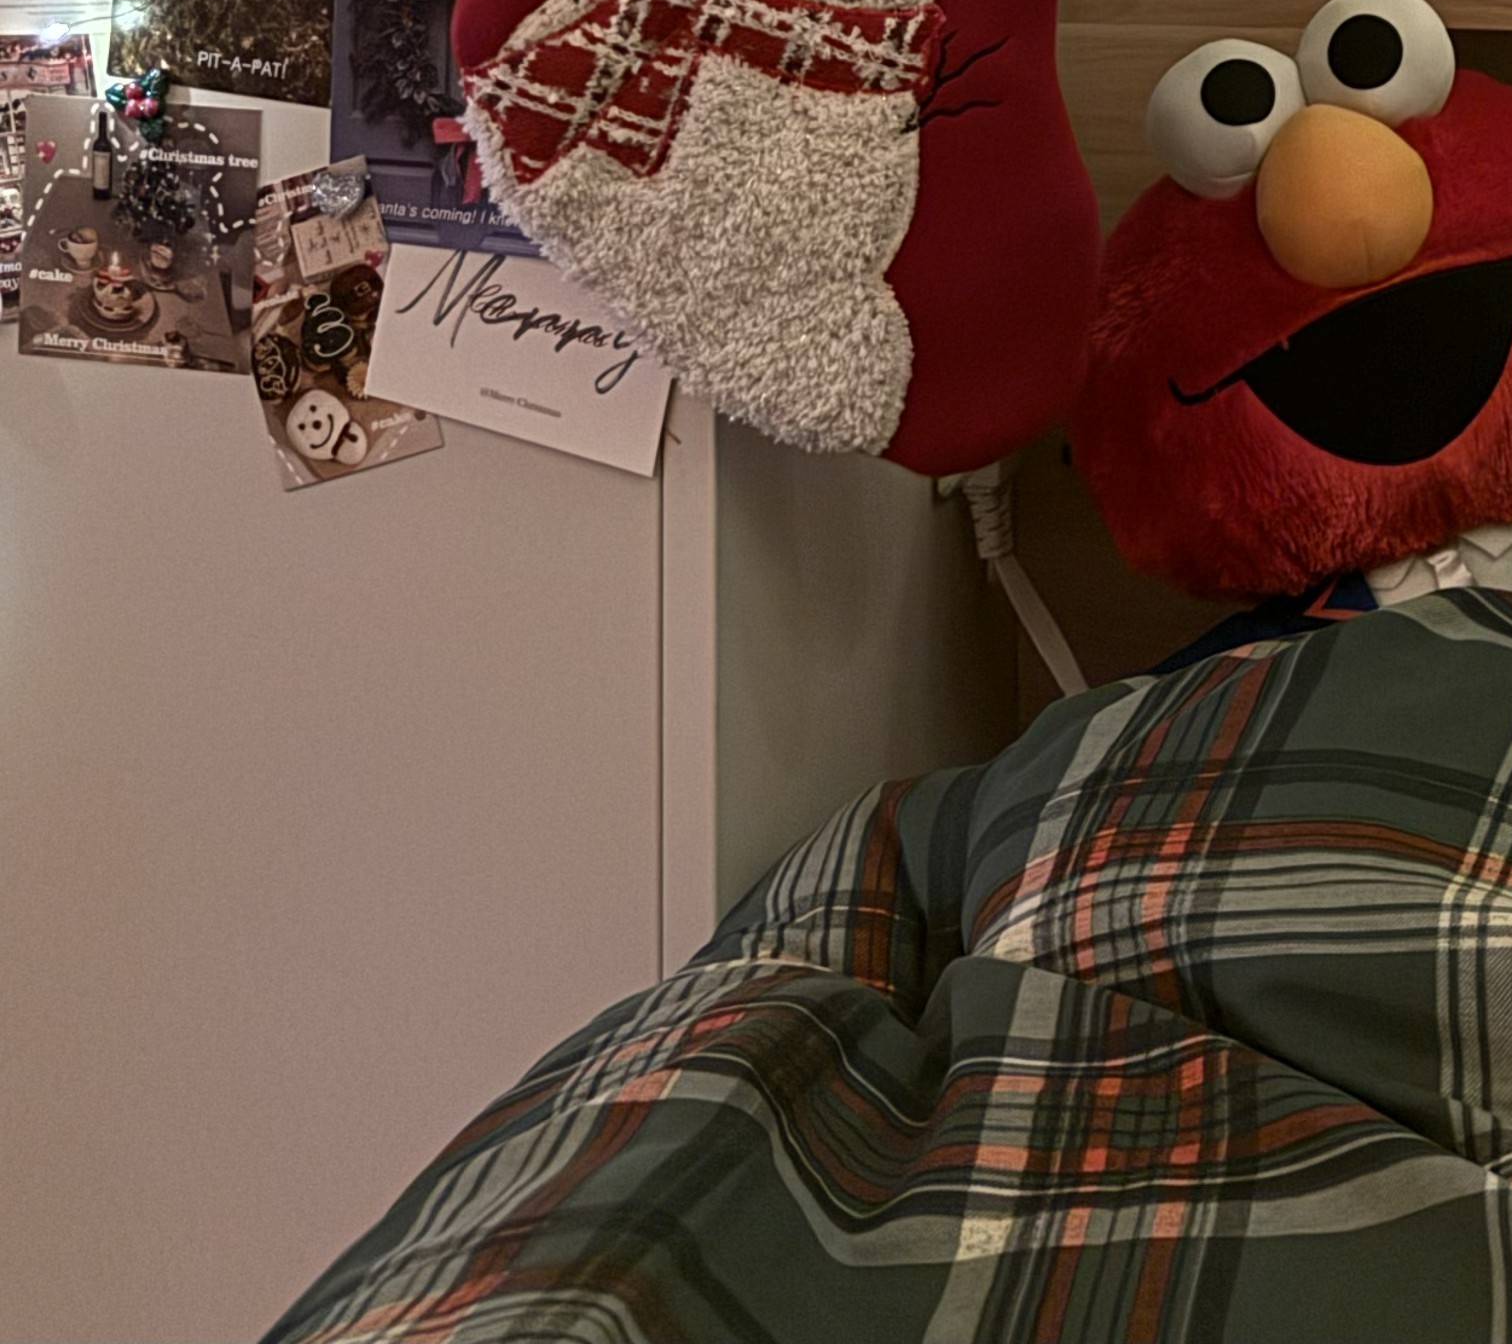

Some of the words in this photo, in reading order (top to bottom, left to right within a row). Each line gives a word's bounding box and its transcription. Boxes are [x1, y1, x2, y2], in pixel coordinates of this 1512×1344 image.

[197, 50, 289, 79] PIT-A-PAT!
[228, 154, 258, 169] tree
[381, 202, 418, 218] anta's
[421, 206, 477, 224] coming!
[28, 268, 74, 283] #cake
